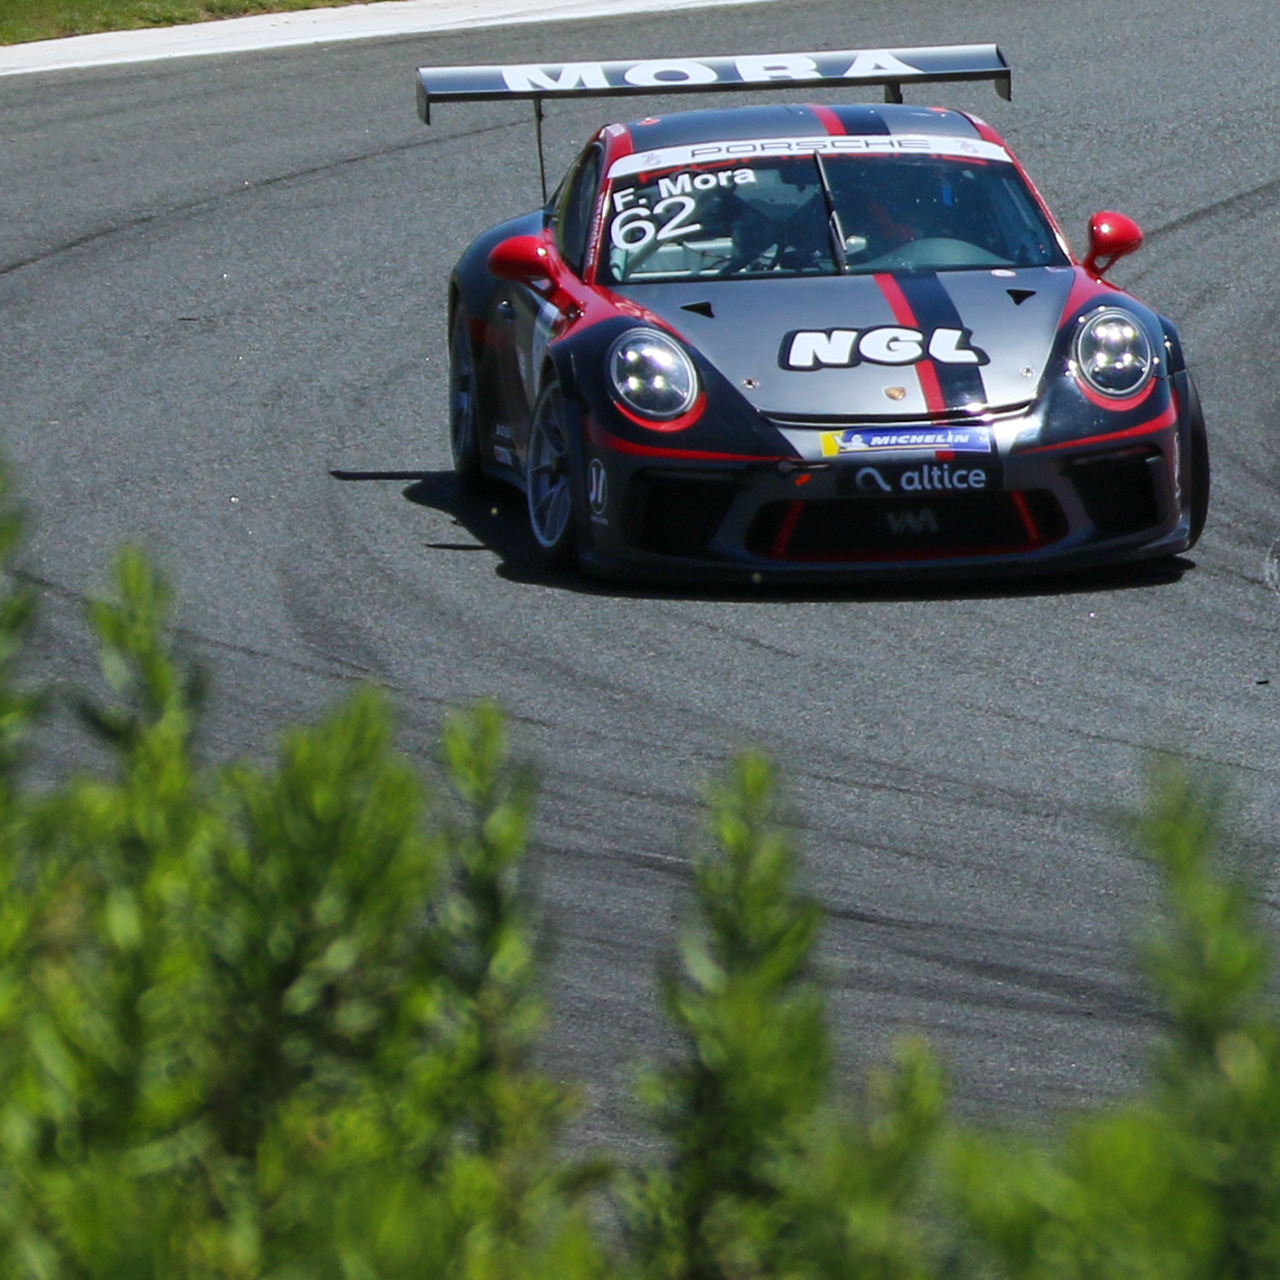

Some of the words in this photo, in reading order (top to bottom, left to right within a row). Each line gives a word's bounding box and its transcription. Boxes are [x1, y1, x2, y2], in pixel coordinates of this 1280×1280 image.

[500, 50, 924, 91] MORA
[690, 138, 931, 159] PORSCHE
[612, 188, 647, 213] F.
[658, 168, 756, 199] Mora
[610, 195, 701, 251] 62
[786, 326, 981, 367] NGL
[869, 433, 969, 446] MICHELIN
[899, 464, 987, 491] altice
